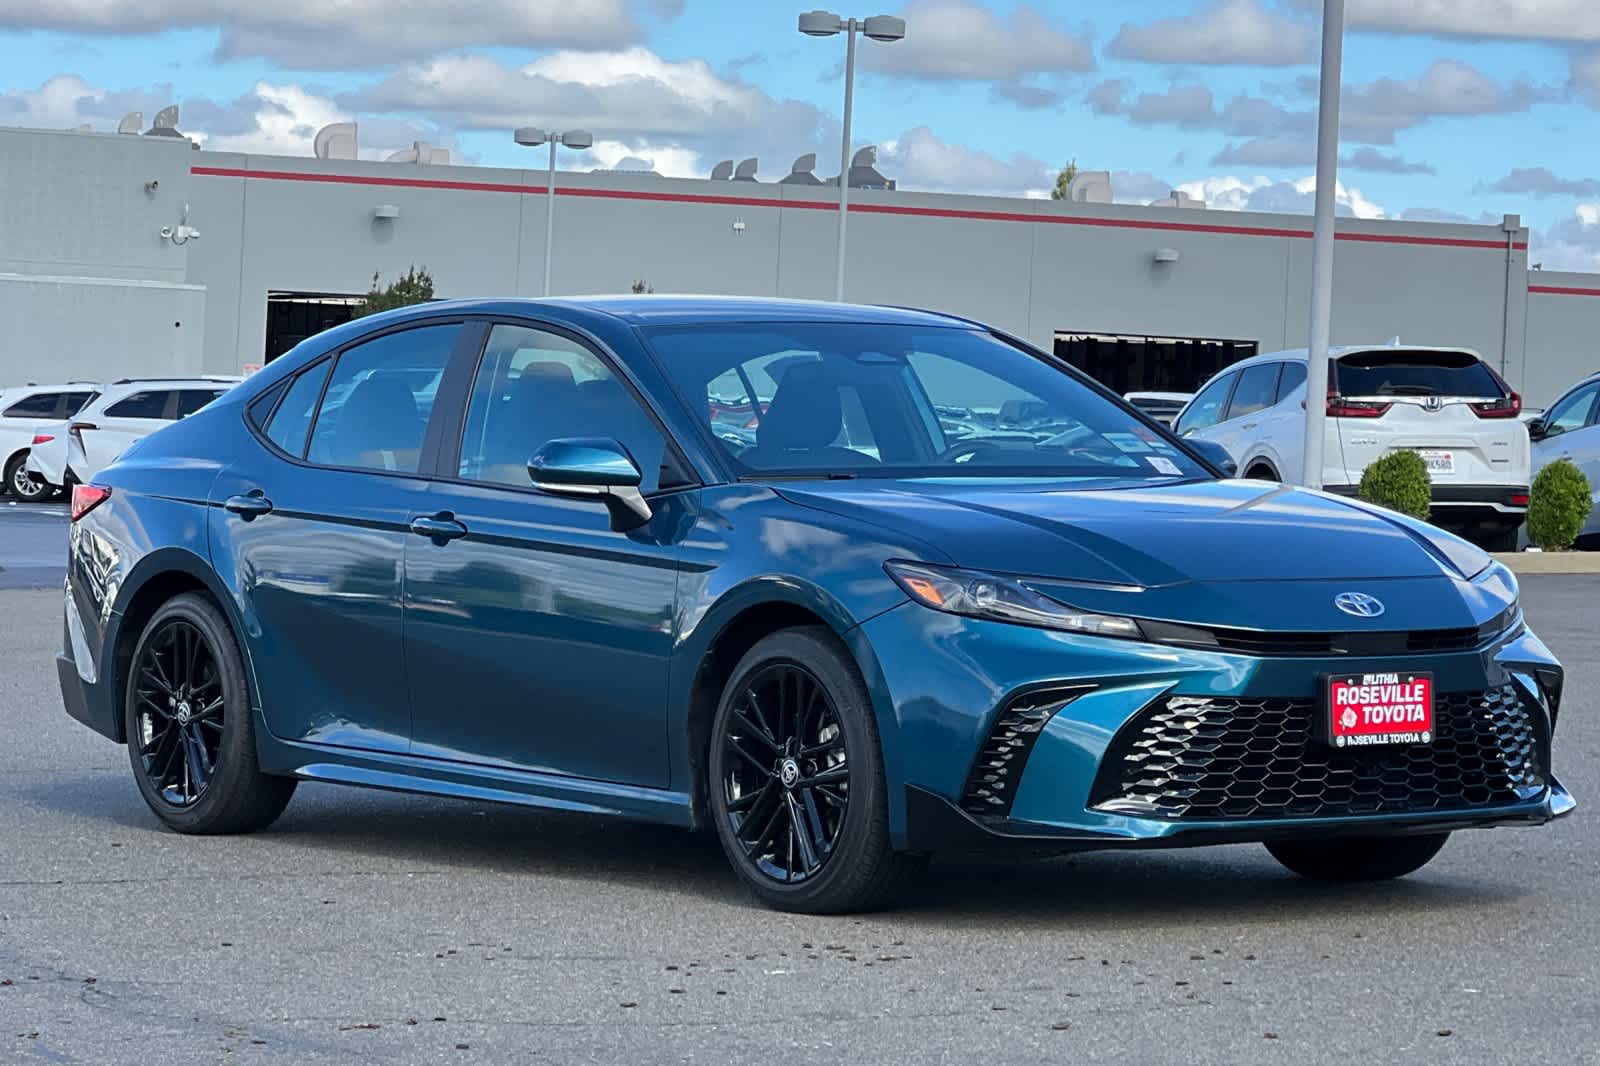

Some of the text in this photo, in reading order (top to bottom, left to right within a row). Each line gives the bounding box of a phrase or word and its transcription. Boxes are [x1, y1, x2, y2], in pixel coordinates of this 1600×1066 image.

[1372, 673, 1399, 685] LITHIA
[1337, 684, 1424, 705] ROSEVILLE
[1362, 704, 1425, 724] TOYOTA
[1347, 732, 1420, 746] ROSEVILLE TOYOTA
